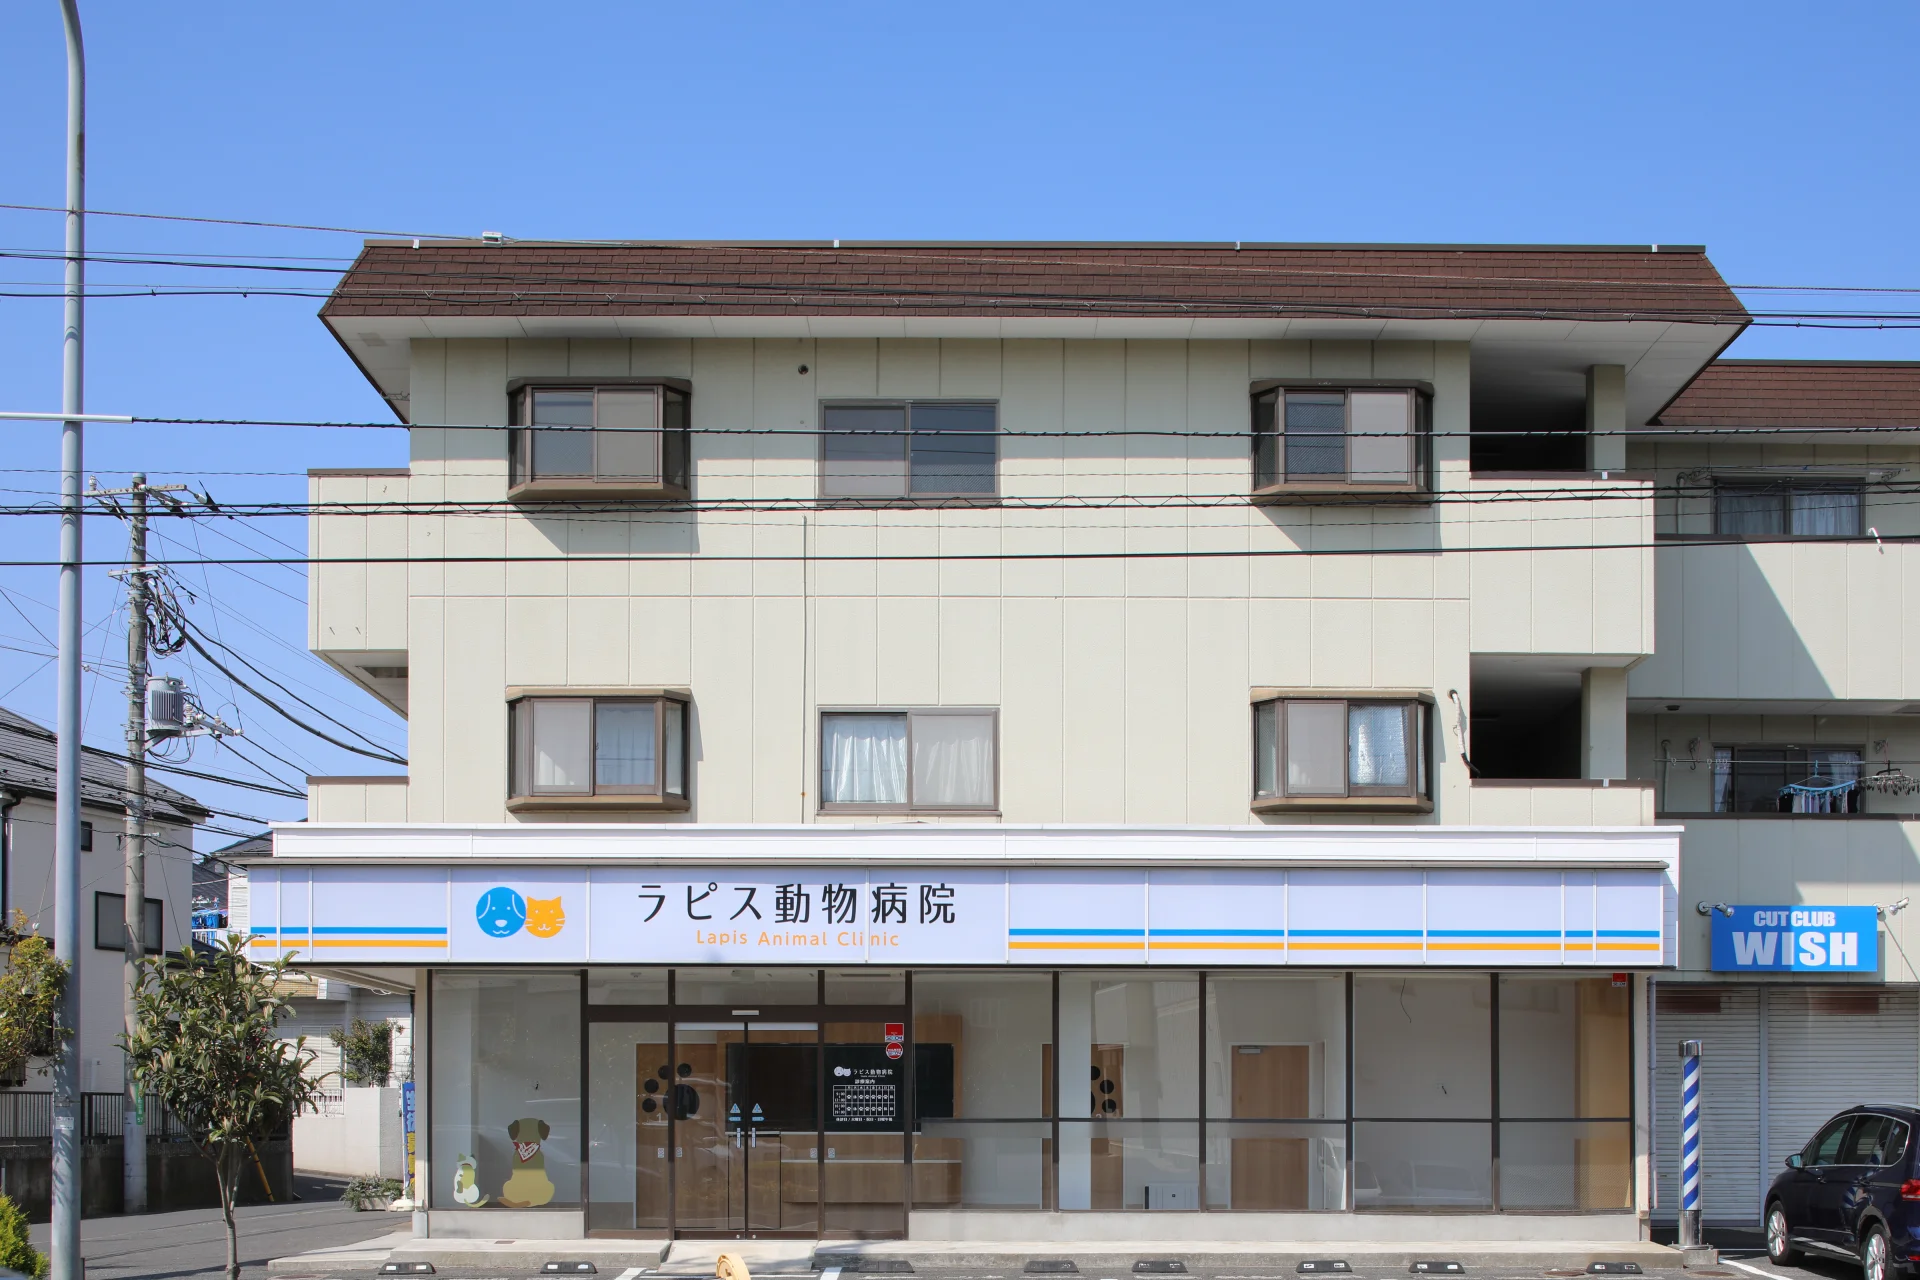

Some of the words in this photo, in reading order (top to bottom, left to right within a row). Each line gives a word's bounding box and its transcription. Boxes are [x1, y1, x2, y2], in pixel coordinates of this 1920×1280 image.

[638, 882, 956, 924] ラピス動物病院
[1753, 911, 1789, 927] CUT
[1790, 911, 1836, 927] CLUB
[696, 930, 748, 946] Lapis
[757, 931, 828, 947] Animal
[837, 931, 899, 947] Clinic
[1731, 931, 1858, 967] WISH
